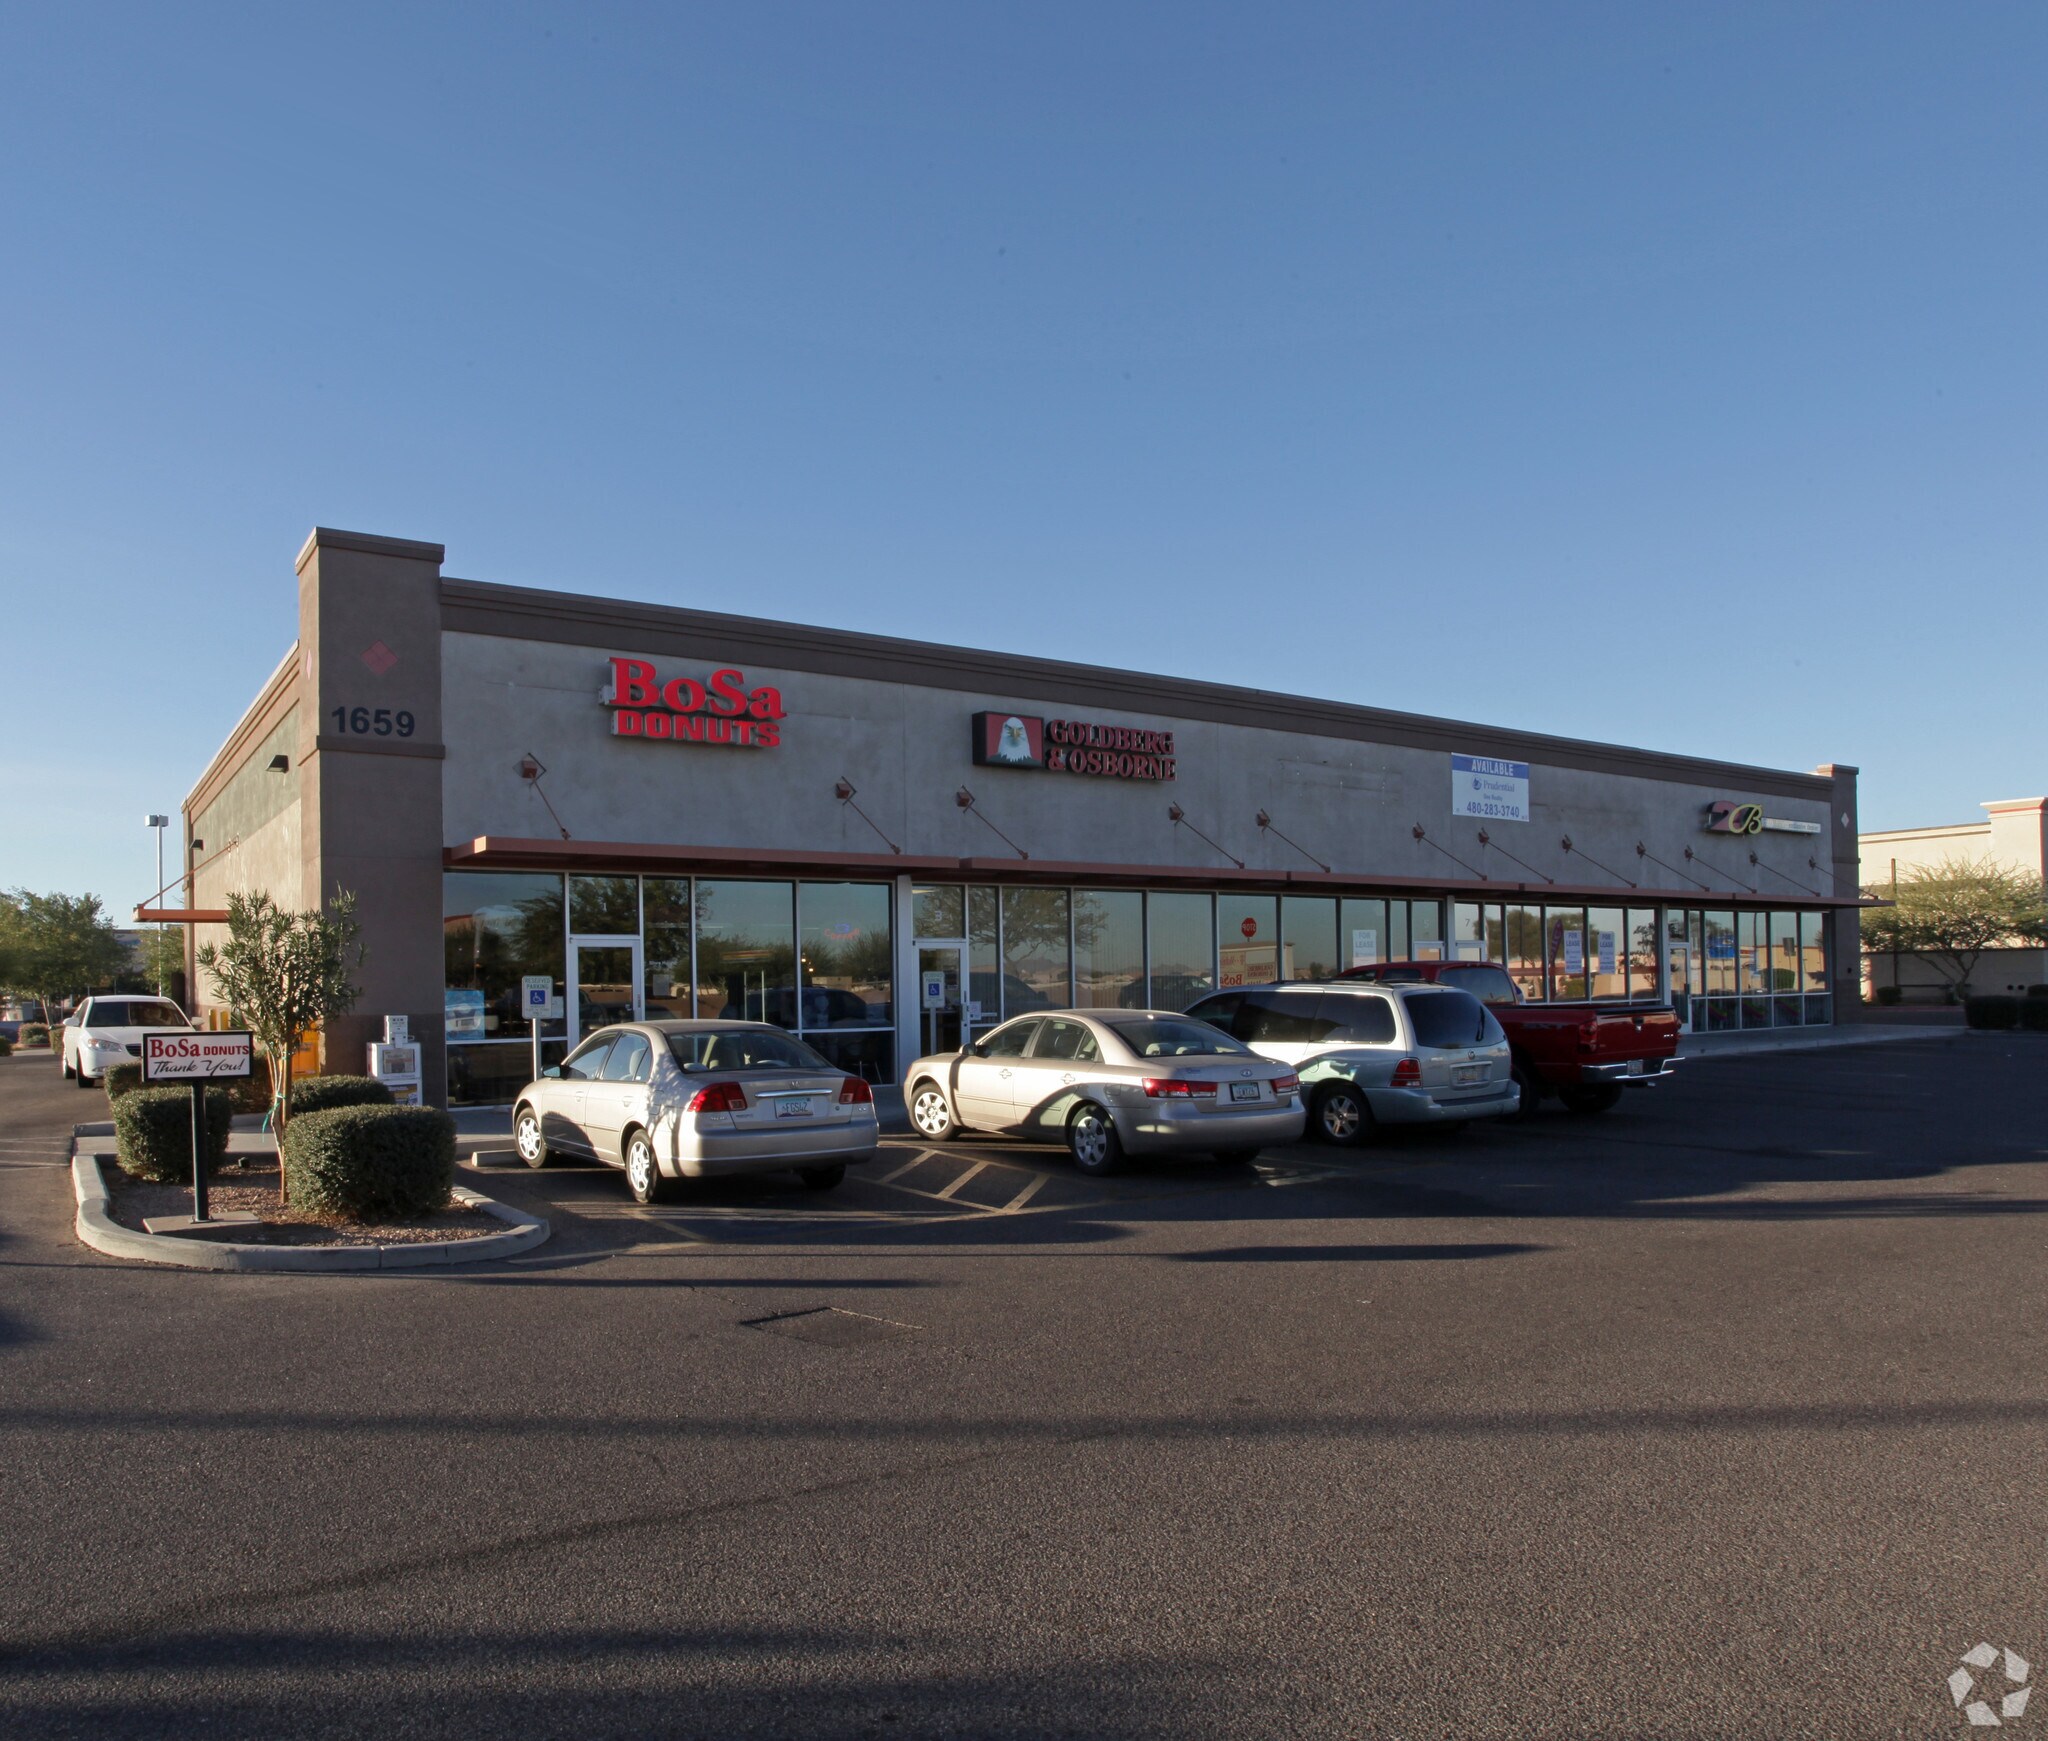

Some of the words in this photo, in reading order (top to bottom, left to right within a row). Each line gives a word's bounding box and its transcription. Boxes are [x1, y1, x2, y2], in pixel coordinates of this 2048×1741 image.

[609, 656, 787, 720] BoSa
[331, 706, 415, 737] 1659
[615, 709, 780, 747] DONUTS
[1048, 719, 1175, 755] GOLDBERG
[1048, 747, 1066, 771] &
[1068, 749, 1177, 781] OSBORNE
[1471, 759, 1514, 776] AVAILABLE
[1483, 779, 1515, 792] Prudential
[1466, 801, 1520, 818] 480-283-3740
[1464, 918, 1471, 928] 7
[1355, 940, 1374, 949] LEASE
[1358, 931, 1371, 940] FOR
[150, 1038, 200, 1058] BoSa
[203, 1045, 249, 1056] DONUTS
[153, 1060, 198, 1075] Thank
[200, 1058, 245, 1077] You!
